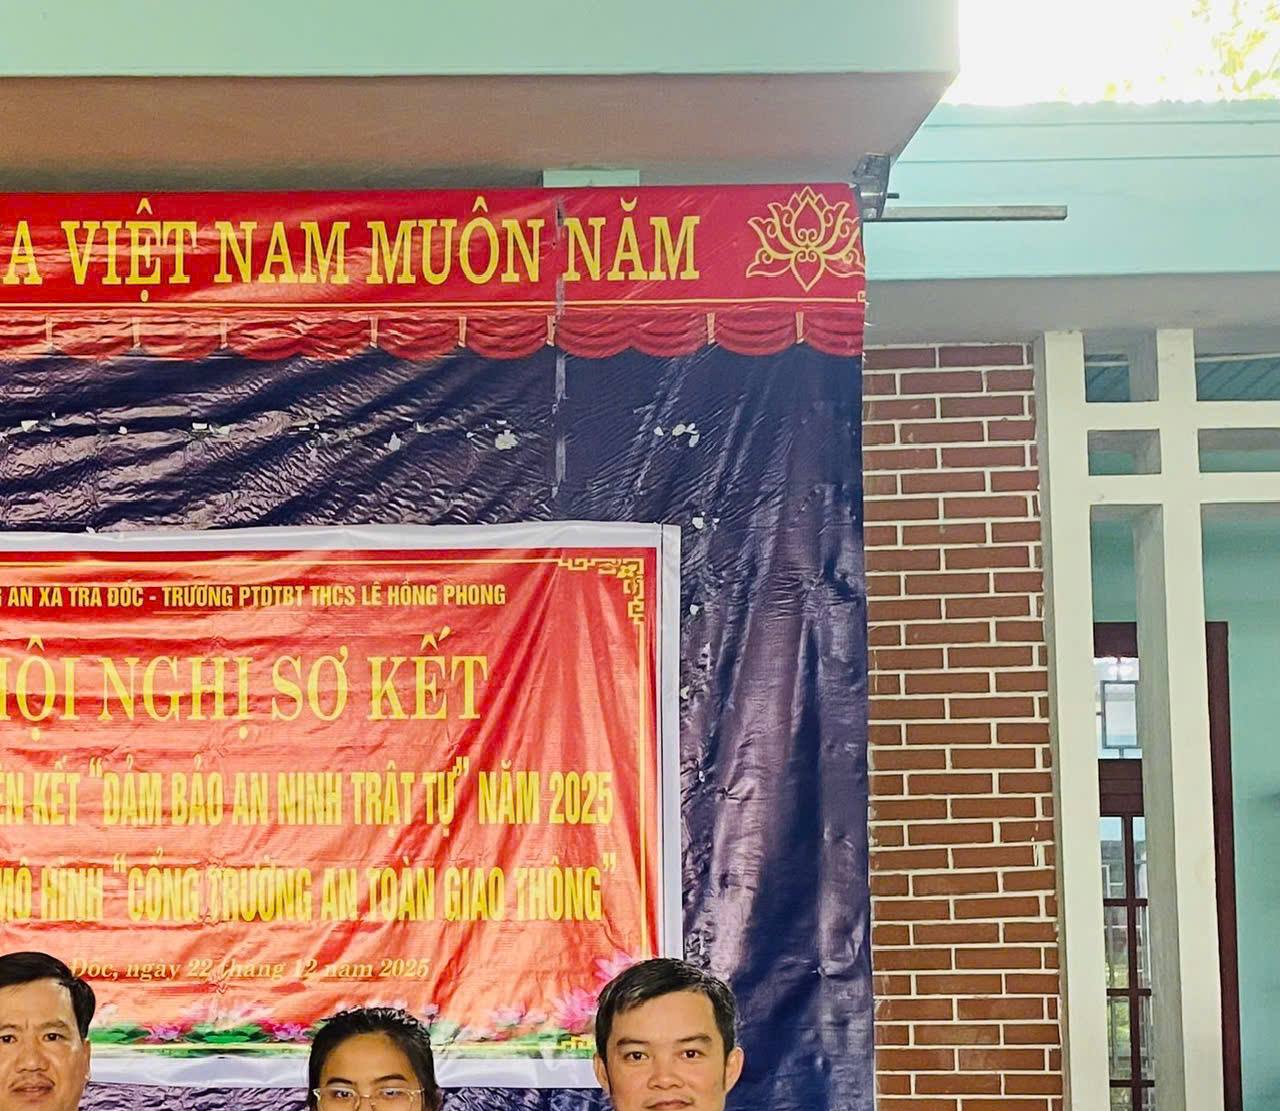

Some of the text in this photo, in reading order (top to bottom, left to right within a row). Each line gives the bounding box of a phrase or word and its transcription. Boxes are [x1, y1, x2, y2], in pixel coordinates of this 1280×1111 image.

[59, 198, 199, 303] VIỆT
[213, 219, 351, 287] NAM
[365, 195, 549, 284] MUÔN
[560, 199, 700, 283] NĂM
[7, 586, 34, 608] AN
[238, 585, 305, 607] PTDTBT
[310, 585, 356, 607] THCS
[361, 580, 382, 607] LÊ
[443, 584, 506, 606] PHONG
[98, 654, 254, 741] NGHỊ
[271, 645, 349, 722] SƠ
[367, 625, 488, 721] KẾT
[32, 755, 81, 826] KẾT
[171, 753, 224, 826] BẢO
[232, 771, 269, 825] AN
[277, 771, 343, 825] NINH
[350, 760, 416, 838] TRẬT
[478, 759, 541, 825] NĂM
[548, 770, 614, 825] 2025
[320, 866, 358, 921] AN
[365, 855, 436, 921] TOÀN
[443, 866, 506, 921] GIAO
[186, 958, 214, 978] 22
